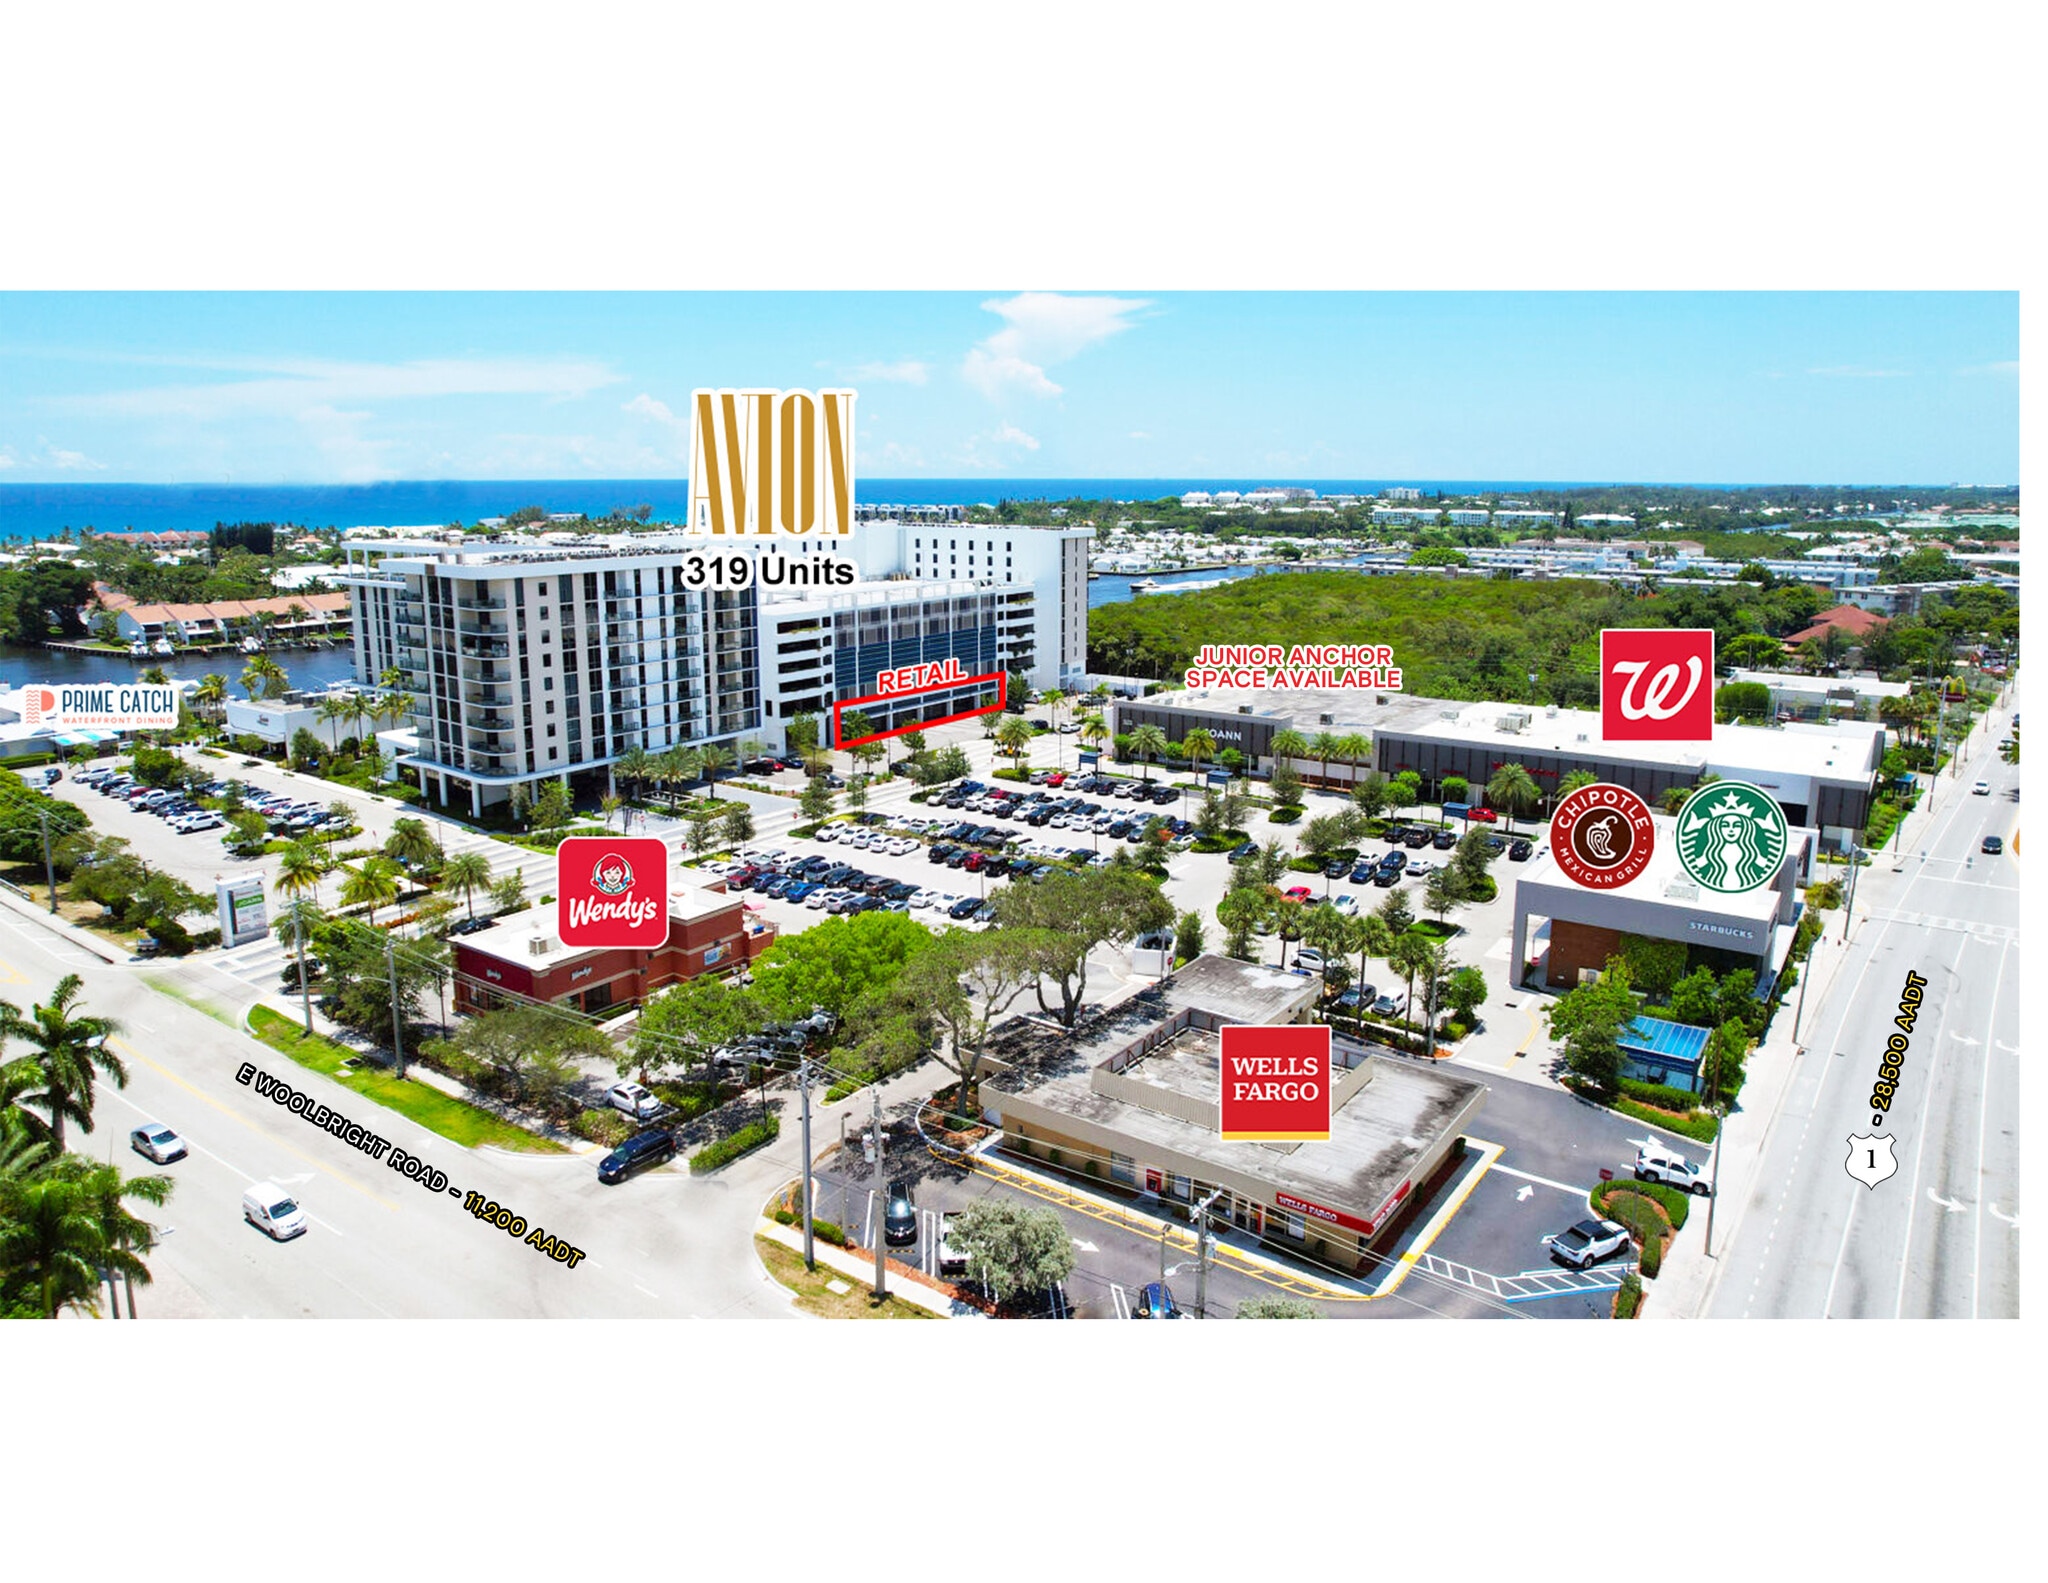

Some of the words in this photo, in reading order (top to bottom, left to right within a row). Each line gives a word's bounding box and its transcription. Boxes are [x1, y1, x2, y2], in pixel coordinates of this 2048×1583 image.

[1205, 728, 1242, 741] OANN
[1689, 921, 1754, 940] STARBUCKS
[1278, 1195, 1308, 1212] WELLS
[1308, 1206, 1338, 1222] FARGO
